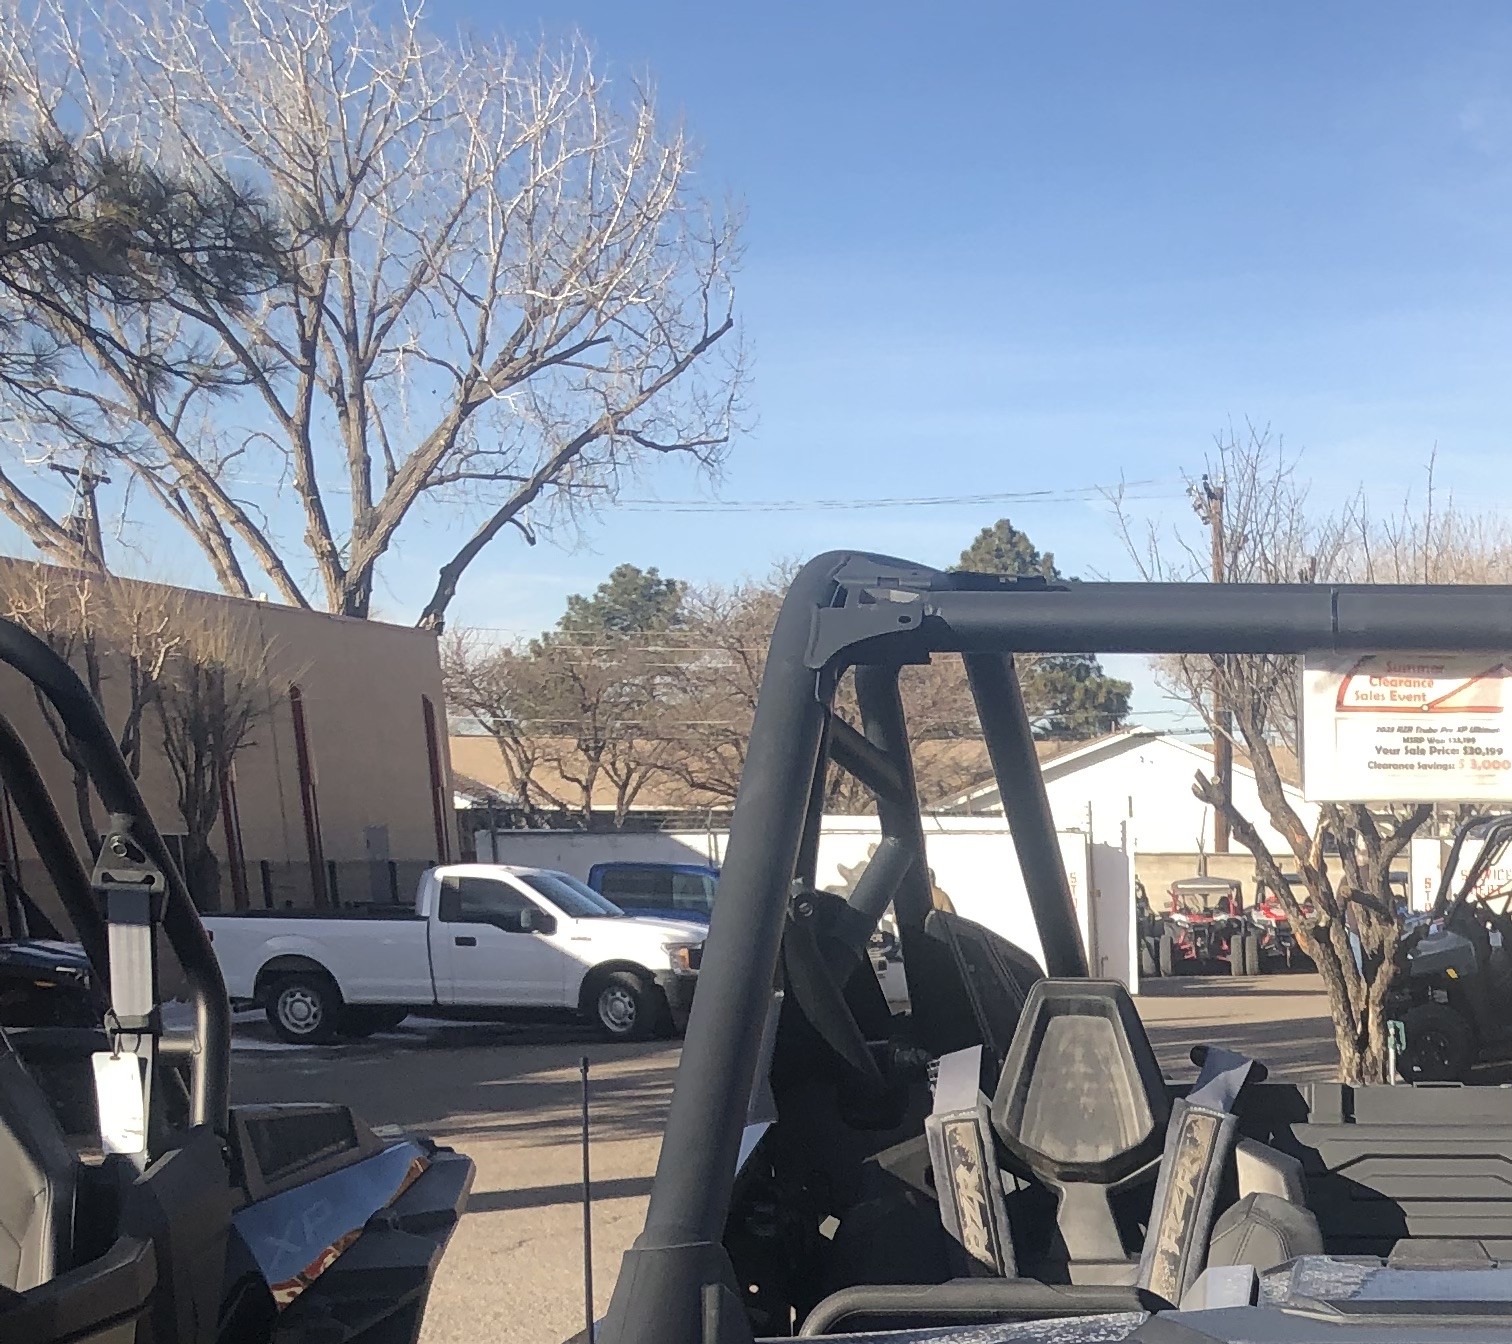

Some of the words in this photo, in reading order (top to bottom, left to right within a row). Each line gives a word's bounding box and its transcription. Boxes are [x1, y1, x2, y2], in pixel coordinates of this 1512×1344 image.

[1369, 674, 1434, 688] Clearance
[1355, 690, 1386, 701] Sales
[1390, 690, 1427, 702] Event
[1375, 745, 1401, 755] Your
[1404, 745, 1427, 756] Sale
[1367, 760, 1415, 770] Clearance
